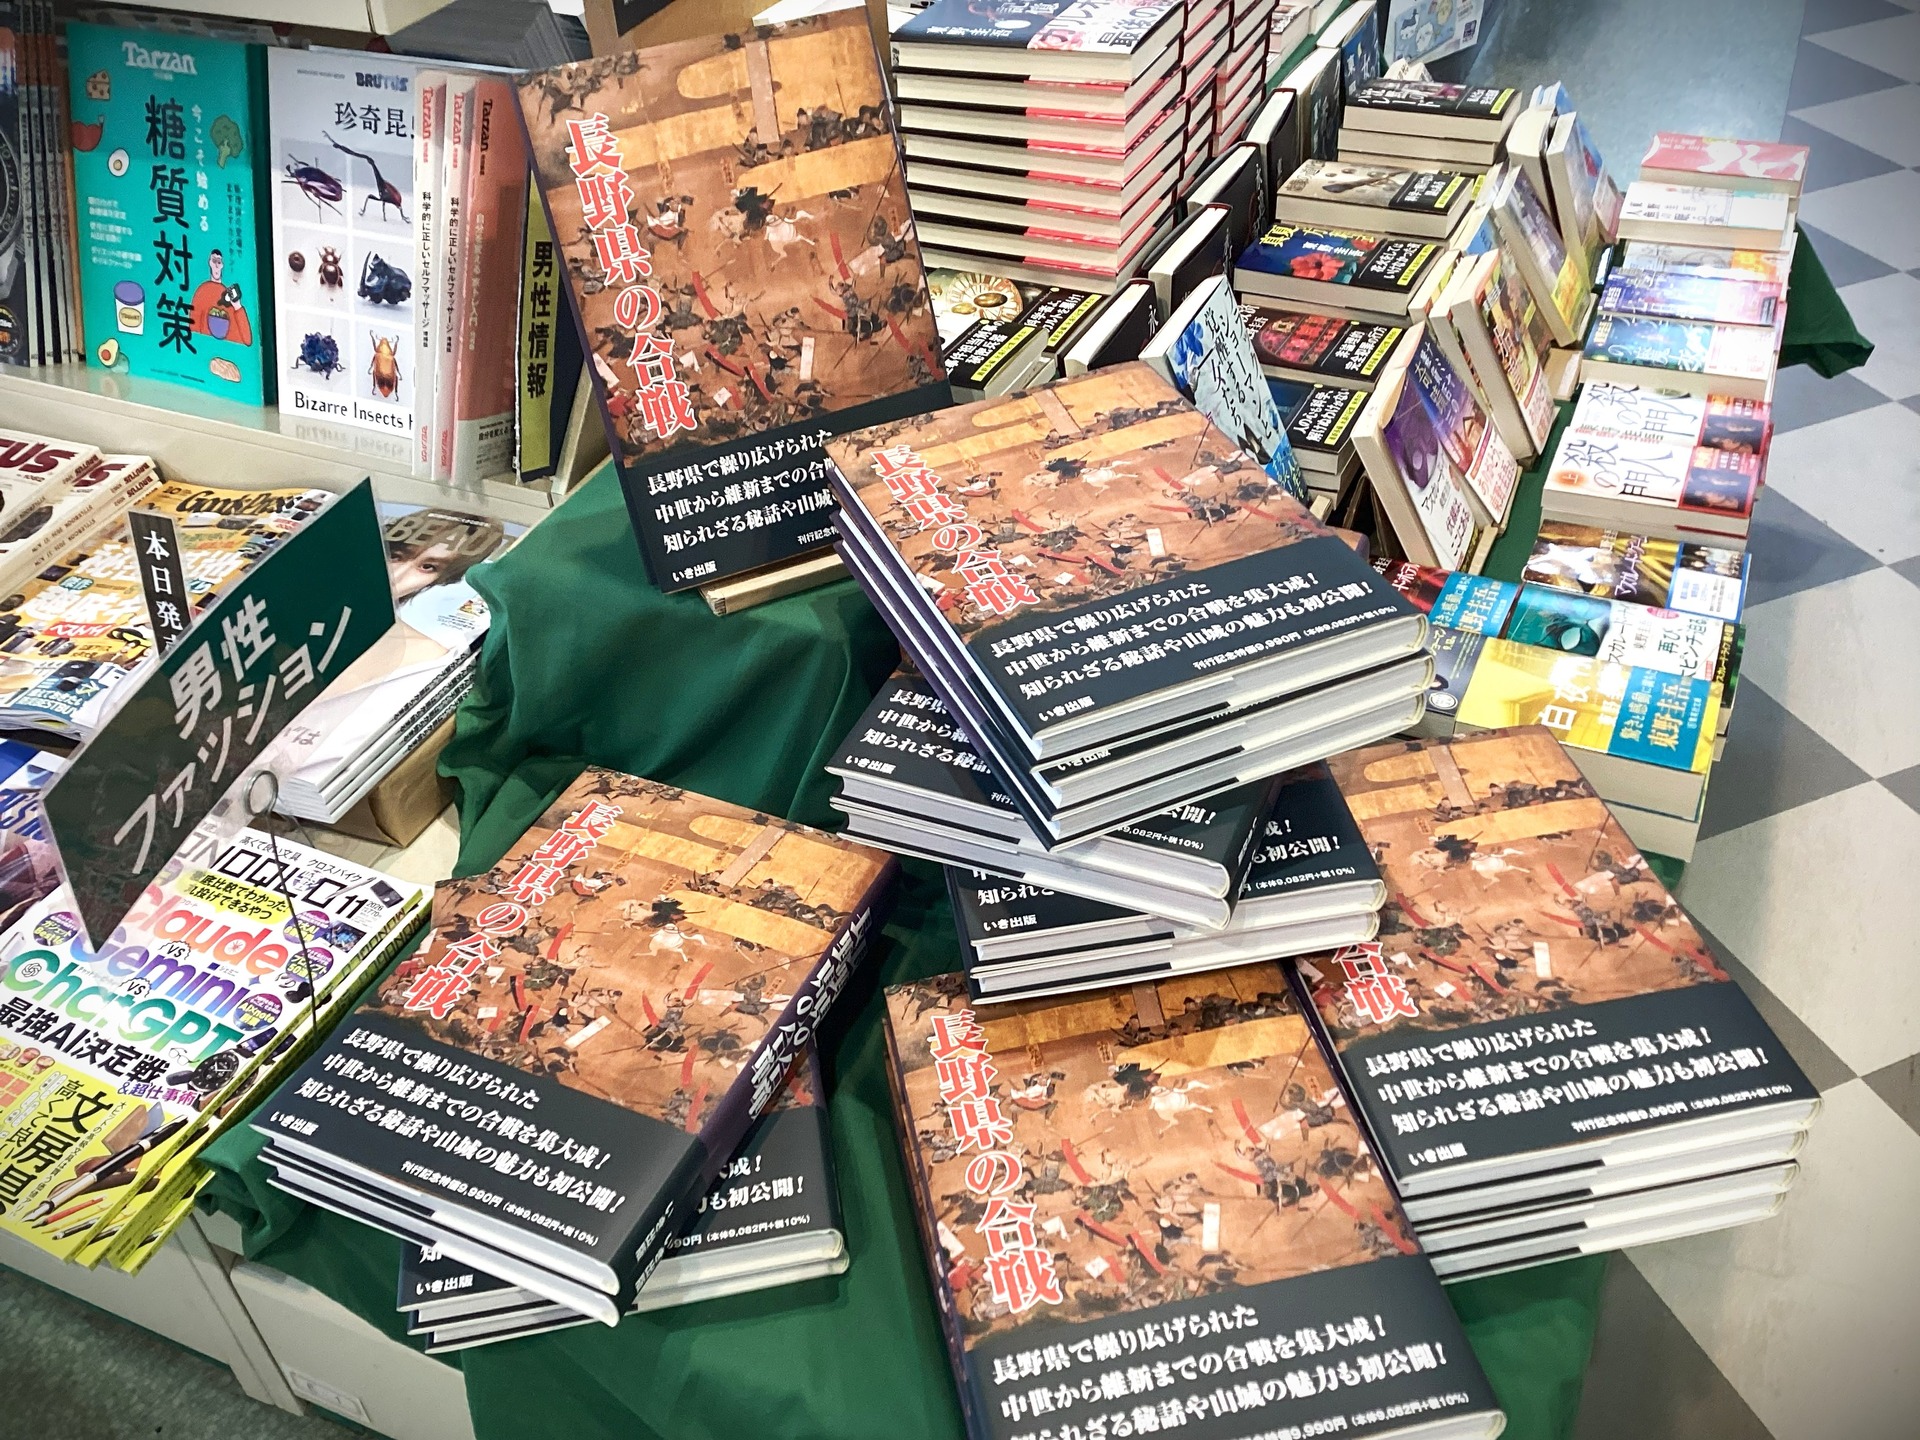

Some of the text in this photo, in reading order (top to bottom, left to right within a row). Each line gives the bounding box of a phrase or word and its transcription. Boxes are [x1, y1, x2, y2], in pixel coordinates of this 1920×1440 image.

[121, 41, 197, 75] Tarzan
[355, 71, 409, 92] BRUTUS
[334, 101, 414, 139] 珍奇昆
[422, 87, 434, 140] Tarzan
[480, 98, 493, 153] Tarzan
[145, 94, 197, 354] 糖質対策
[565, 113, 697, 439] 長野県の合戦
[527, 241, 553, 399] 男性情報
[294, 390, 405, 429] Bizarre Insects
[124, 462, 150, 484] BRUTUS
[127, 475, 153, 497] BRUTUS
[648, 429, 833, 496] 長野県で繰り広げられた
[870, 444, 1041, 614] 長野県の合戦
[672, 560, 717, 583] いき出版
[991, 581, 1211, 659] 長野県で繰り広げられた
[1004, 572, 1320, 678] 中世から維新までの合戦を集大成！
[1019, 580, 1373, 700] 知られざる秘話や山城の魅力も初公開！
[169, 594, 277, 740] 男性
[113, 606, 352, 875] ファッション
[1038, 695, 1095, 723] いき出版
[1647, 677, 1692, 750] 東野圭吾
[845, 755, 897, 775] いき出版
[402, 799, 625, 1020] 長野県の合戦
[983, 914, 1038, 932] いき出版
[127, 981, 146, 996] VS
[167, 943, 187, 958] VS
[1332, 940, 1420, 1024] 合戦
[0, 996, 170, 1083] 最強AI決定戦
[3, 948, 246, 1069] ChatGPT
[1365, 1017, 1597, 1078] 長野県で繰り広げられた
[343, 1027, 540, 1111] 長野県で繰り広げられた
[1378, 1026, 1713, 1105] 中世から維新までの合戦を集大成！
[1392, 1046, 1769, 1135] 知られざる秘話や山城の魅力も初公開！
[269, 1109, 319, 1136] いき出版
[294, 1076, 626, 1214] 知られざる秘話や山城の魅力も初公開！
[322, 1054, 611, 1170] 中世から維新までの合戦を集大成！
[929, 1009, 1063, 1314] 長野県の合戦
[1408, 1142, 1467, 1166] いき出版
[416, 1272, 474, 1296] いき出版
[993, 1303, 1259, 1387] 長野県で繰り広げられた
[1000, 1314, 1386, 1423] 中世から維新までの合戦を集大成！
